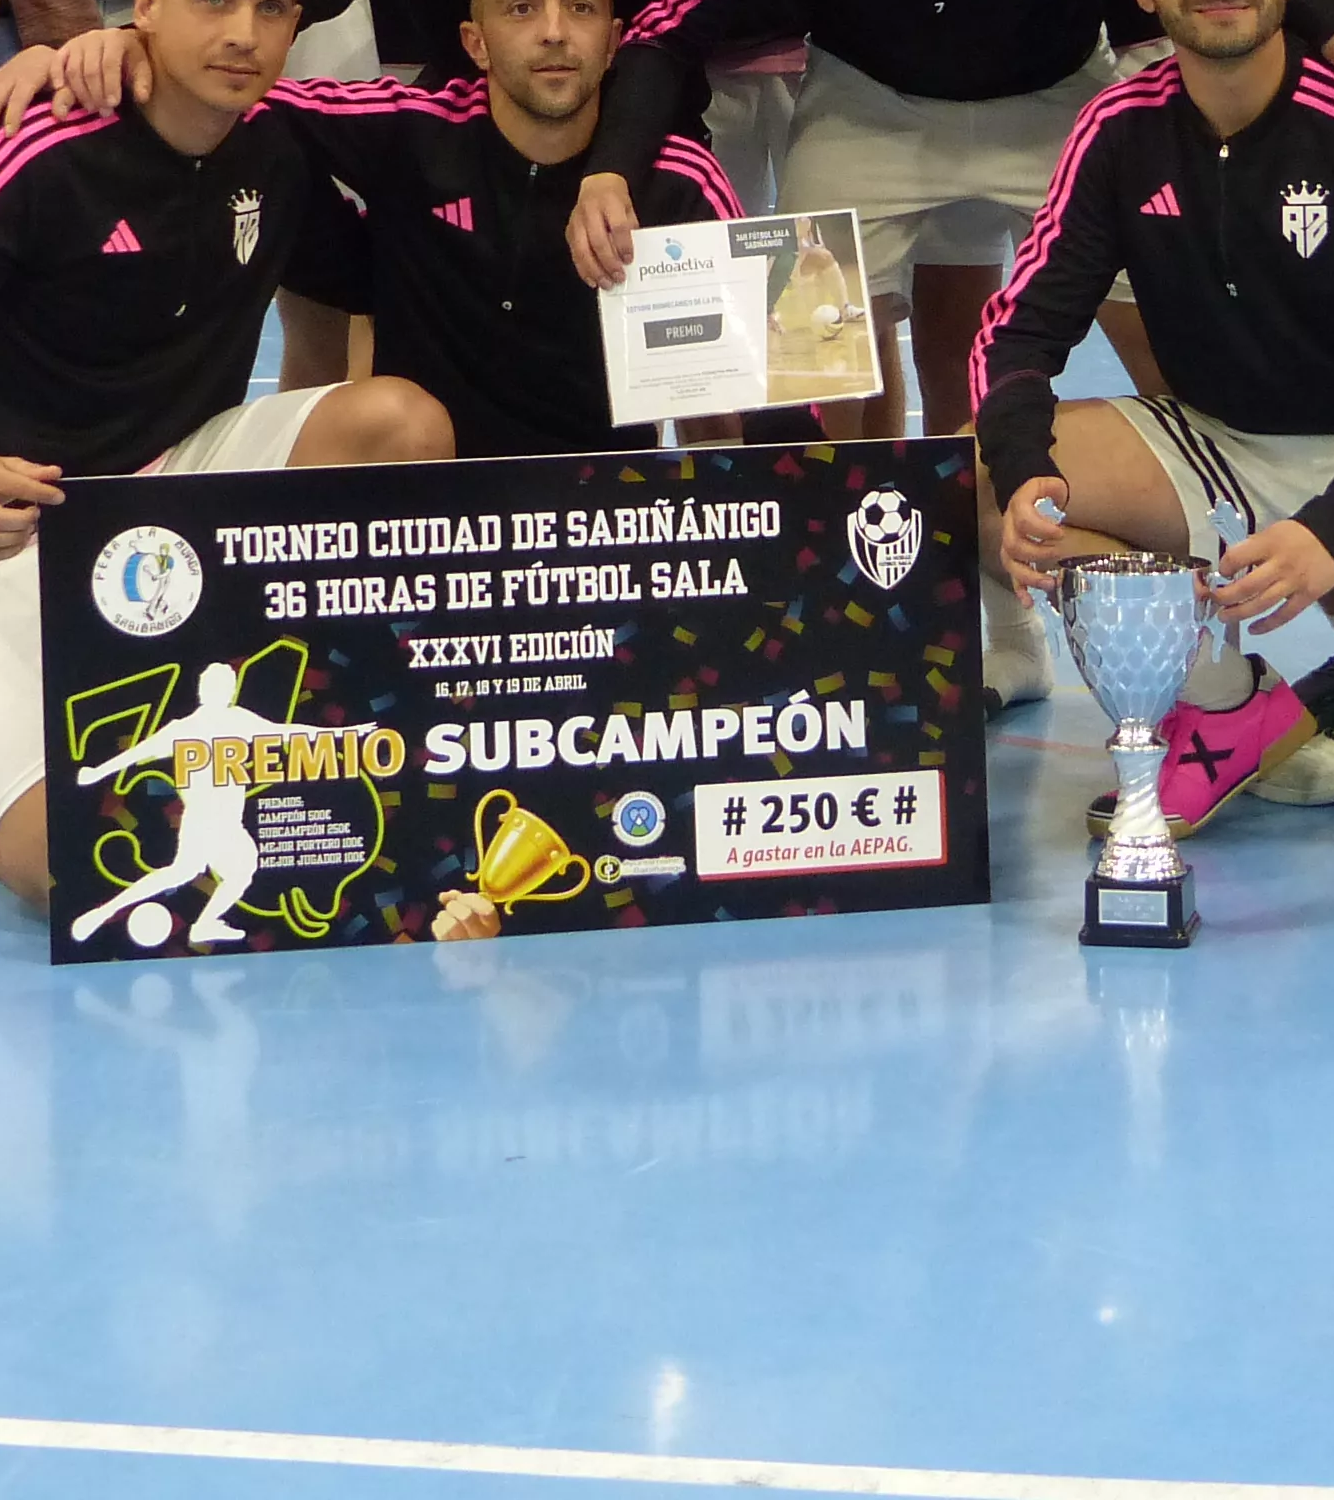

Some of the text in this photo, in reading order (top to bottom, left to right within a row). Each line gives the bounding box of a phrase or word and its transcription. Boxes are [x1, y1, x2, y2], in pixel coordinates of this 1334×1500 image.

[639, 258, 715, 282] podoactiva
[665, 323, 704, 340] PREMIO
[216, 496, 781, 566] TORNEO CIUDAD DE SABIÑÁNIGO
[265, 556, 749, 620] 36 HORAS DE FÚTBOL SALA
[408, 625, 616, 669] XXXVI EDICIÓN
[476, 679, 491, 696] 18
[492, 678, 503, 695] Y
[506, 678, 520, 694] 19
[523, 676, 542, 692] DE
[544, 674, 588, 692] ABRIL
[173, 689, 865, 790] PREMIO SUBCAMPEÓN
[760, 790, 839, 835] 250
[850, 786, 882, 828] €
[726, 835, 914, 868] A gastar en la AEPAG.
